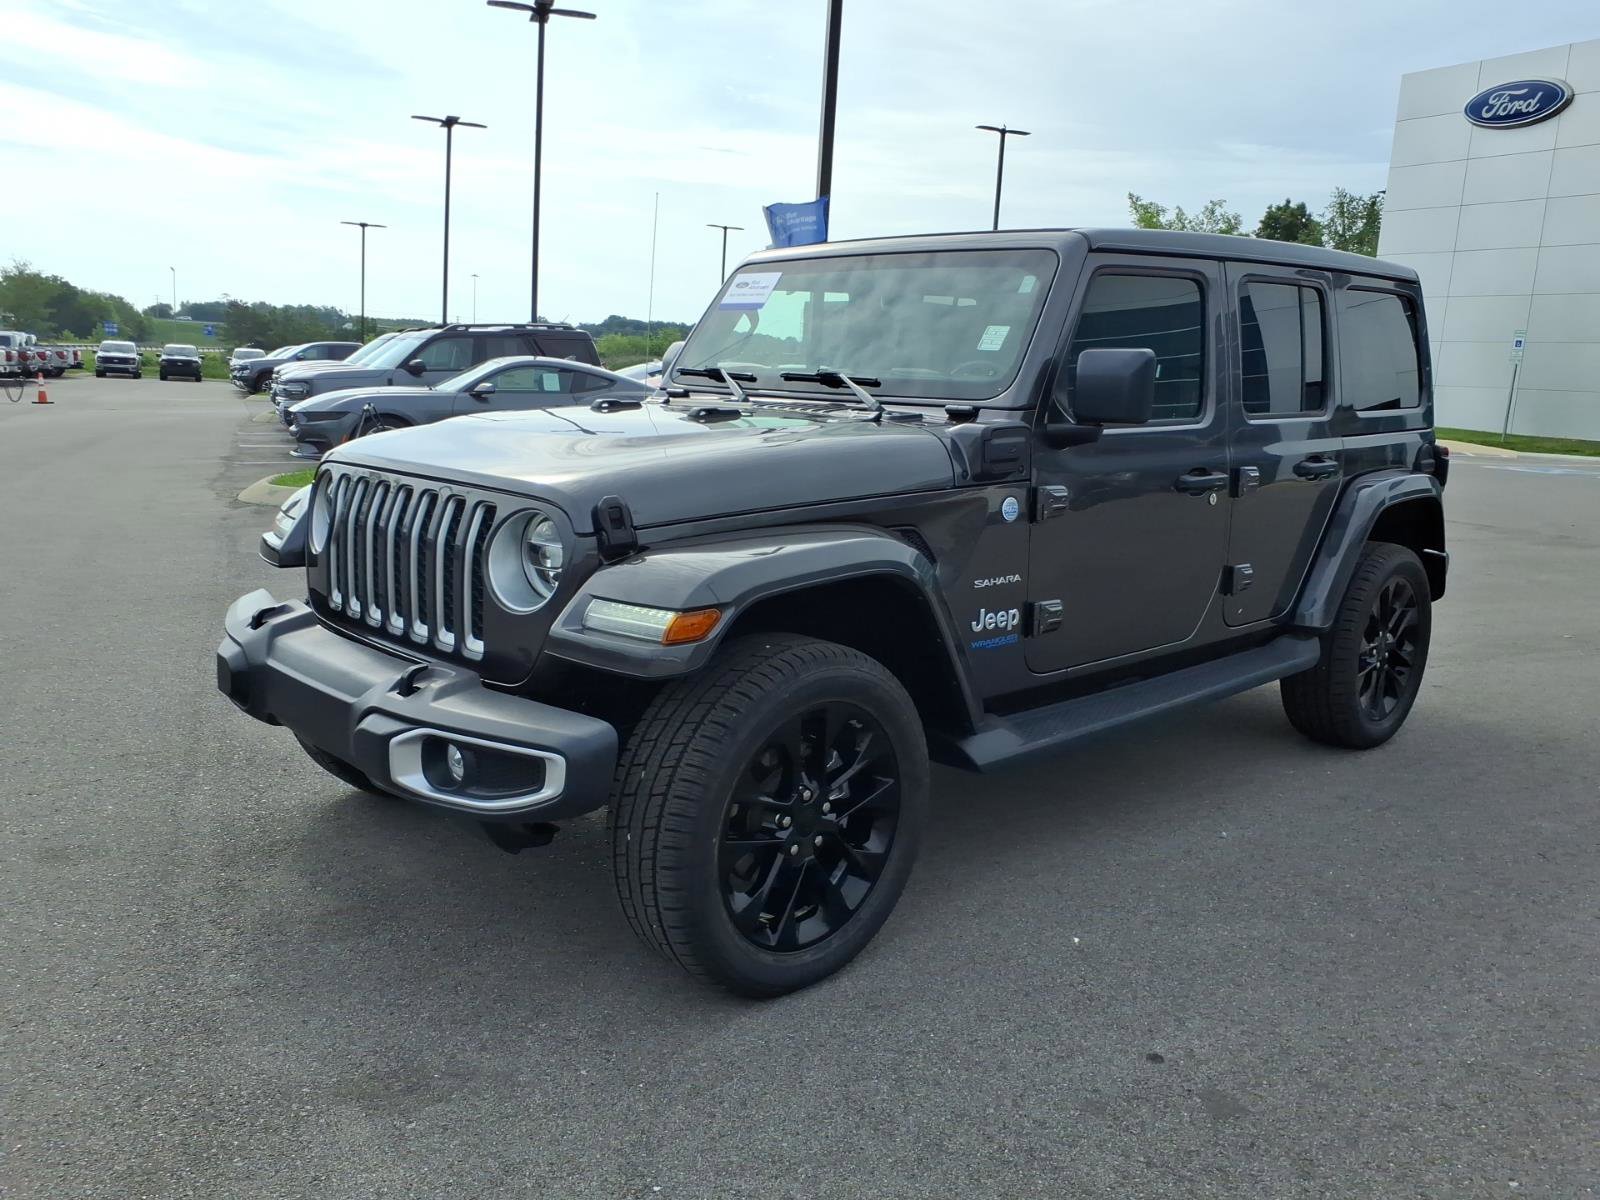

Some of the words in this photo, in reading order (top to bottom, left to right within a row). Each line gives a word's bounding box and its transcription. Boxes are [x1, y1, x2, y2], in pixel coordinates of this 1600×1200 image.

[1482, 88, 1543, 119] Ford
[974, 574, 1021, 588] SAHARA
[971, 608, 1020, 632] Jeep
